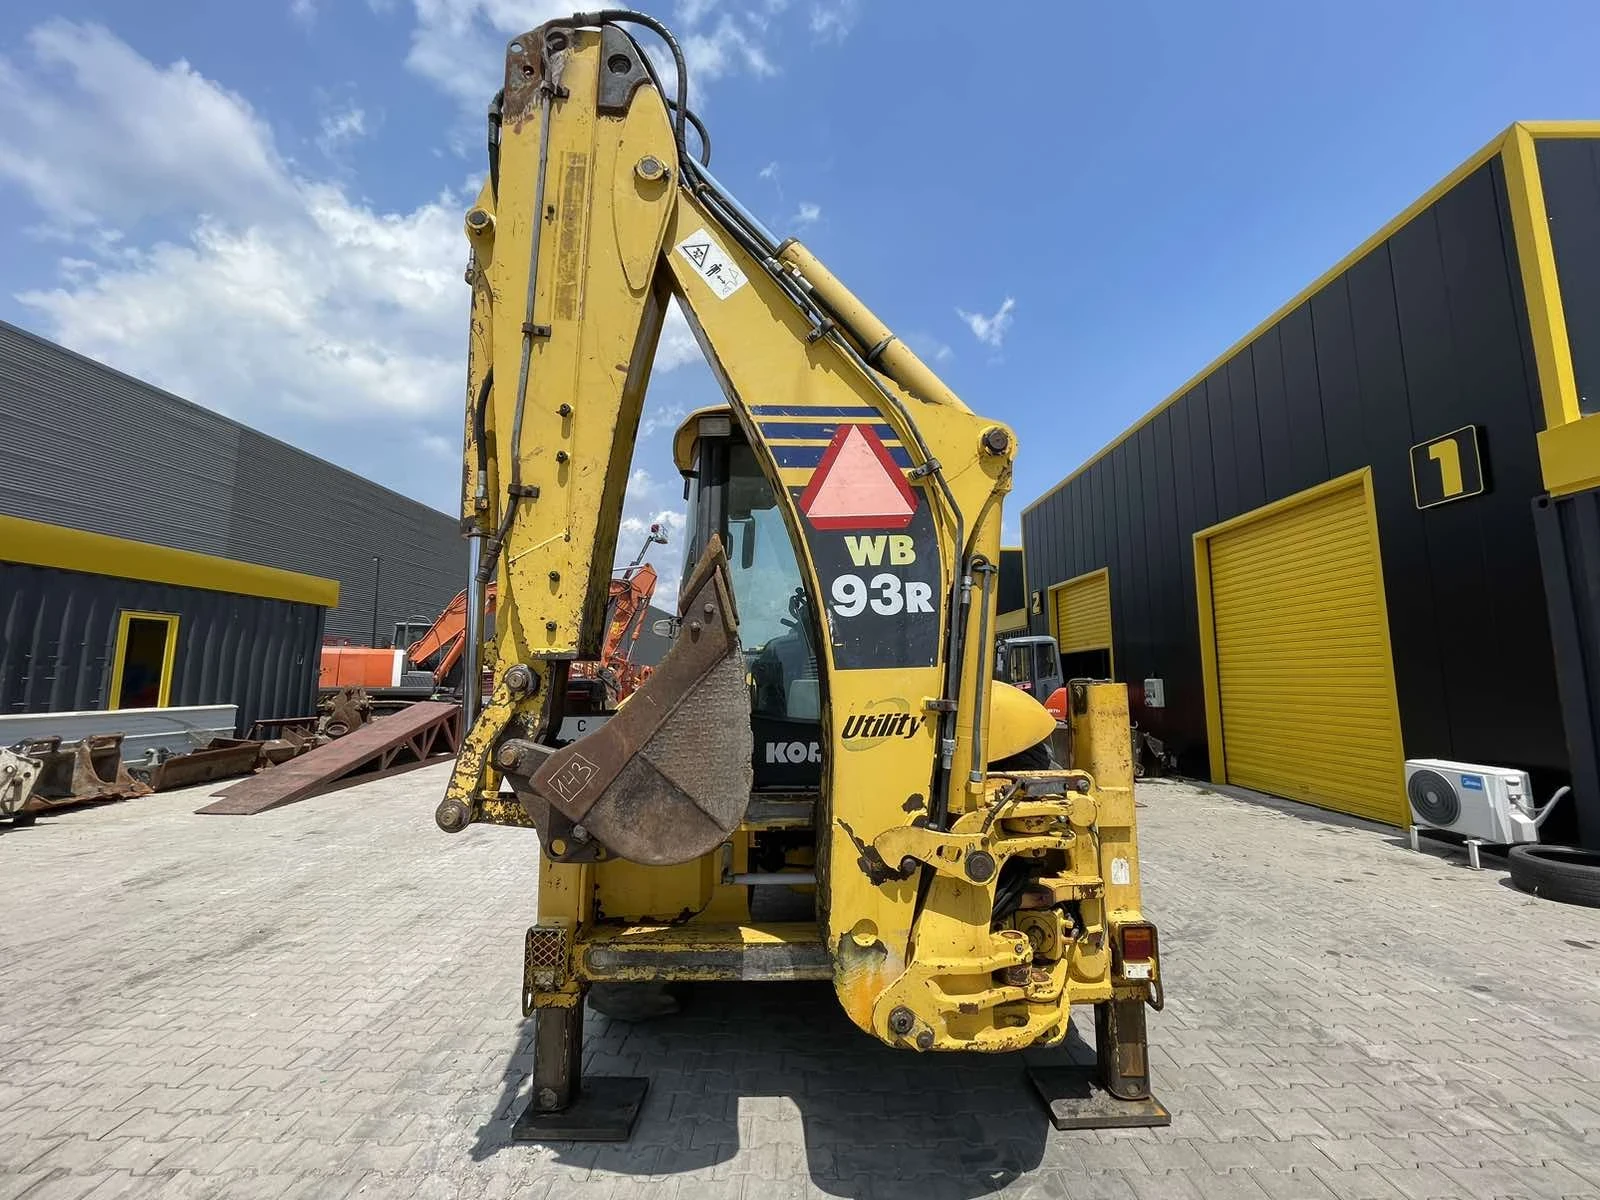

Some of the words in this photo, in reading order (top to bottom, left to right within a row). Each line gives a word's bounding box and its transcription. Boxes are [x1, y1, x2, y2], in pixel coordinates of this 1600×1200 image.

[1428, 438, 1464, 498] 1
[843, 534, 917, 567] WB
[831, 573, 936, 618] 93R
[1032, 591, 1040, 614] 2
[841, 712, 927, 740] Utility
